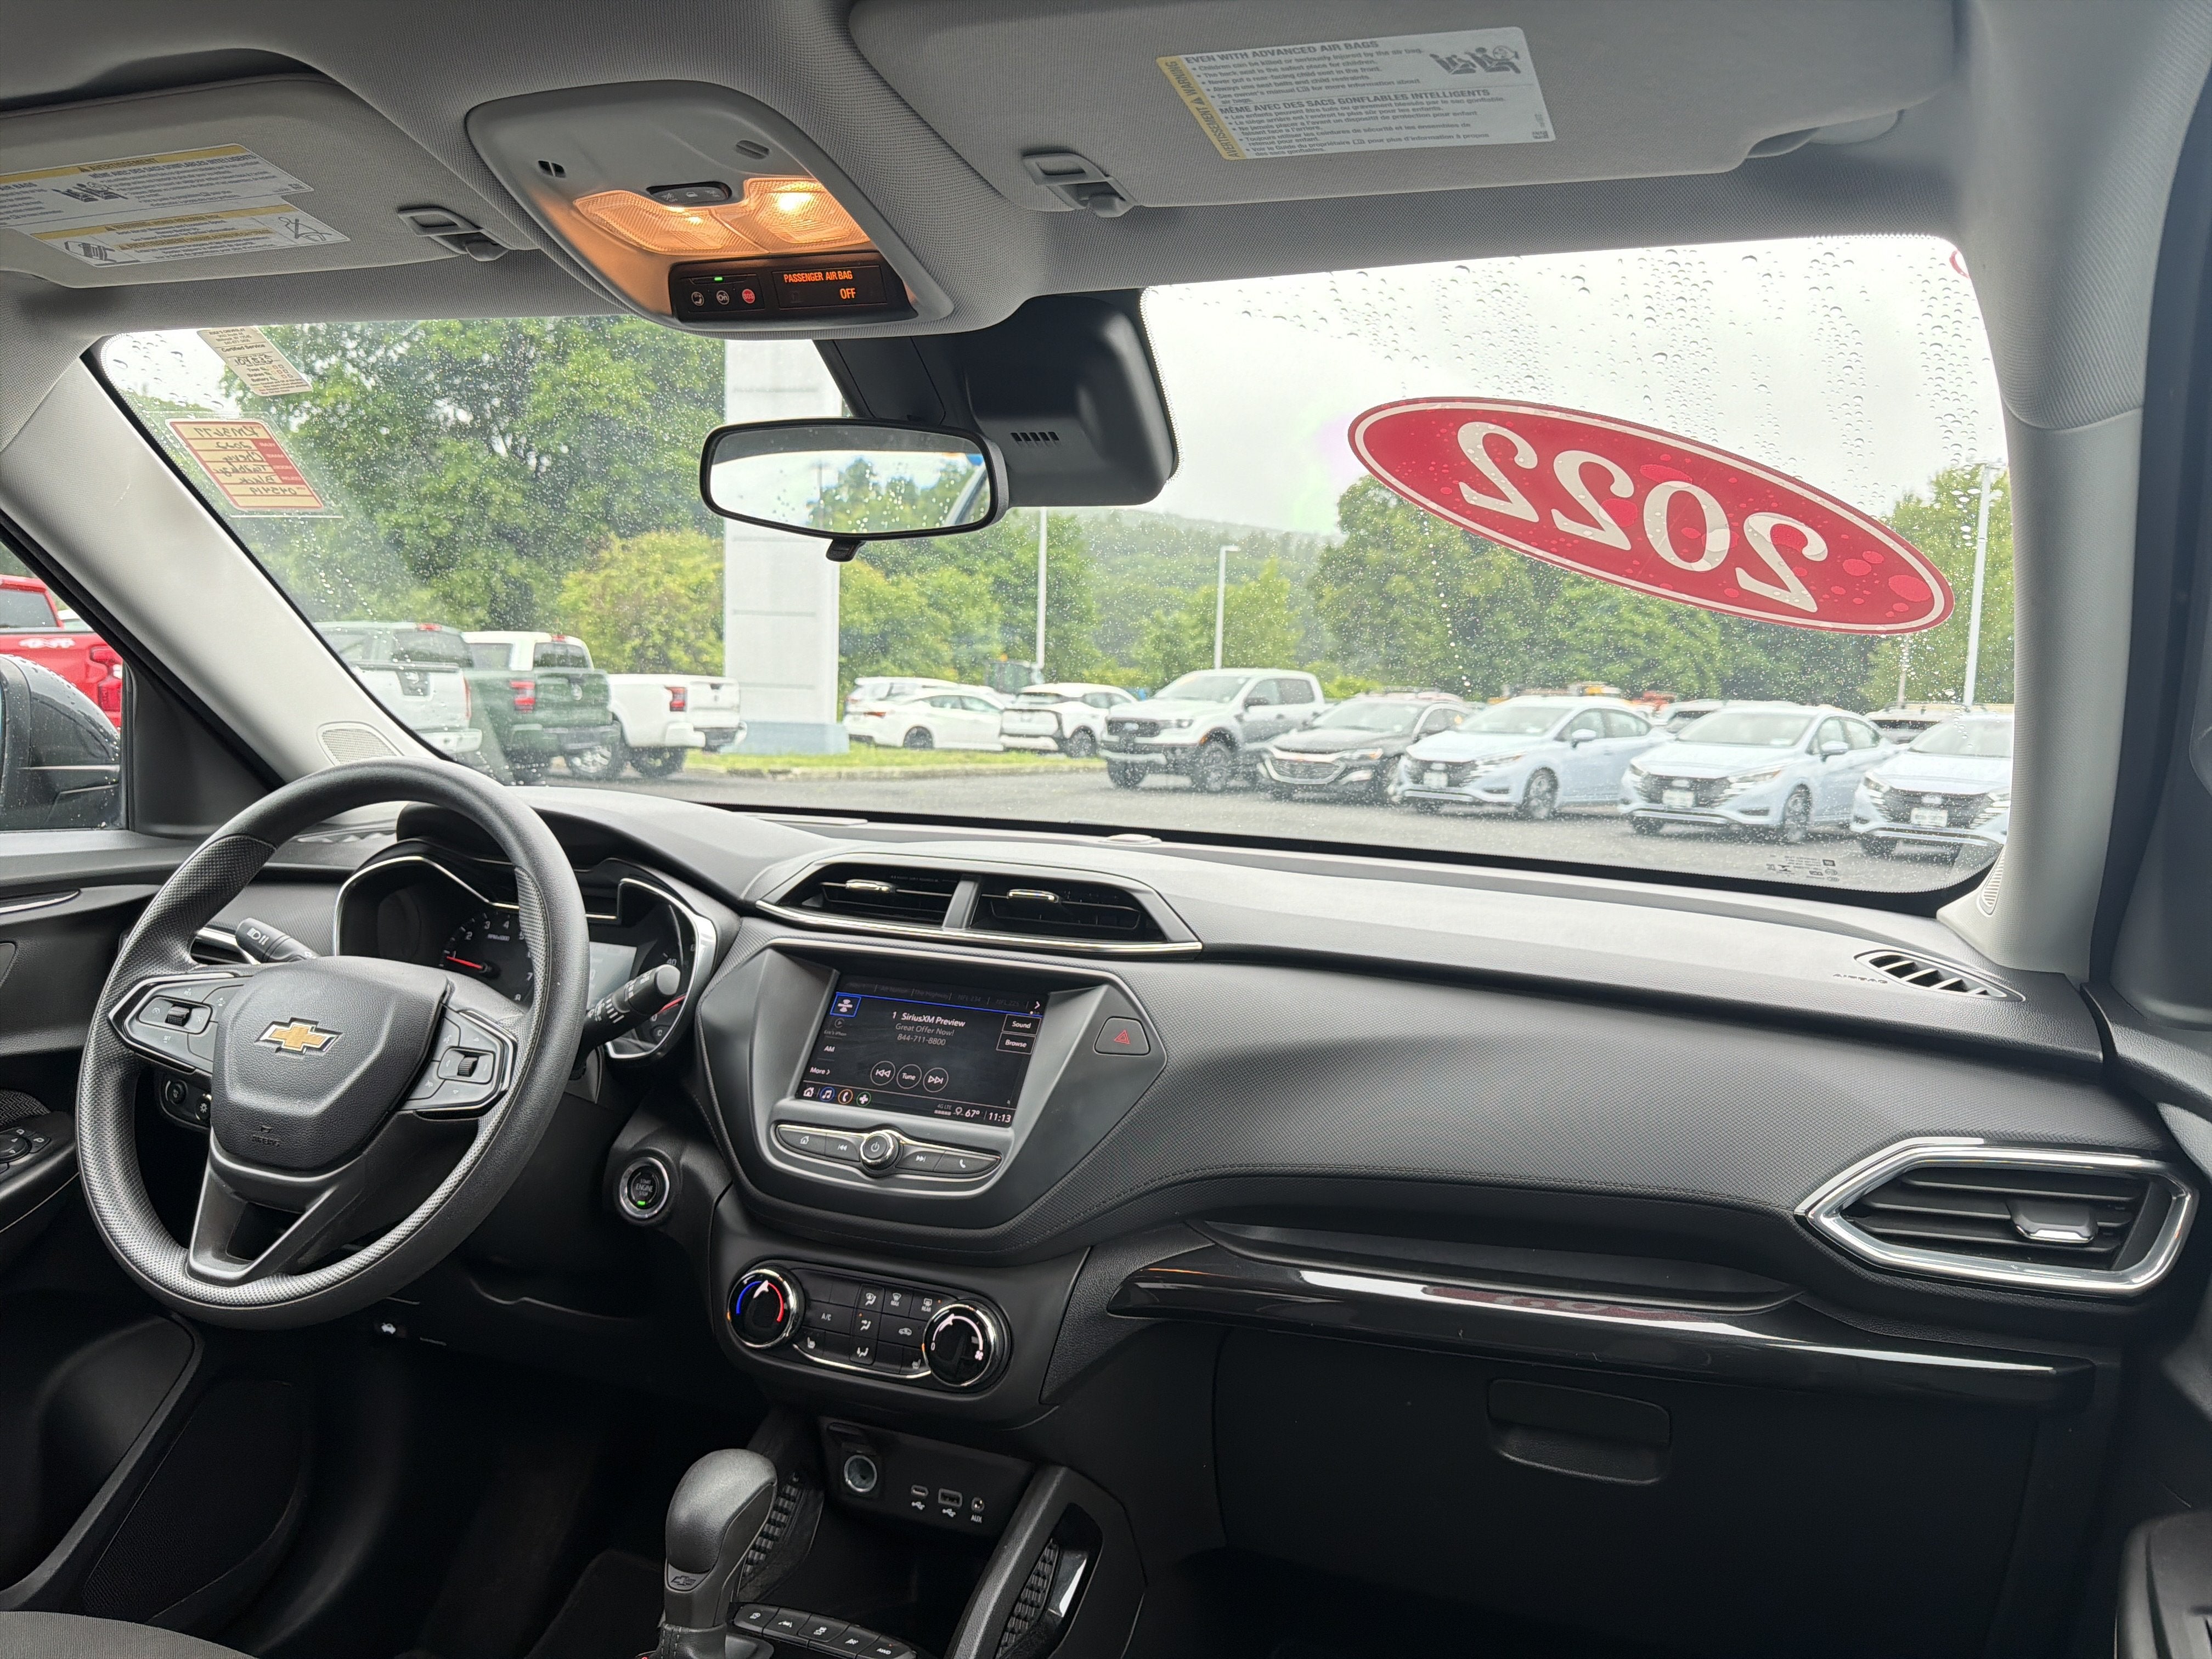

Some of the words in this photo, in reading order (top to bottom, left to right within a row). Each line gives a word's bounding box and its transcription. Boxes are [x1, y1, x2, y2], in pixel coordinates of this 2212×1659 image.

[1184, 55, 1215, 63] EVEN
[1217, 52, 1249, 60] WITH
[1250, 46, 1317, 58] ADVANCED
[1344, 41, 1379, 50] BAGS
[1198, 63, 1232, 71] Children
[1294, 55, 1331, 64] seriously
[1332, 52, 1362, 60] injured
[1165, 61, 1197, 95] WARNING
[1347, 80, 1395, 88] information
[1218, 105, 1251, 114] MÊME
[1306, 99, 1335, 107] SACS
[1337, 93, 1408, 105] GONFLABLES
[1411, 88, 1489, 100] INTELLIGENTS
[1195, 106, 1240, 157] AVERTISSEMENT
[89, 157, 160, 172] AVERTISSEMENT
[783, 272, 824, 283] PASSENGER
[826, 272, 838, 280] AIR
[838, 270, 853, 280] BAG
[718, 292, 727, 301] On
[839, 288, 856, 299] OFF
[483, 921, 490, 930] 3
[503, 921, 510, 929] 4
[465, 931, 473, 940] 2
[526, 972, 533, 981] 7
[892, 1011, 898, 1020] 1
[901, 1013, 935, 1024] SiriusXM
[935, 1016, 966, 1028] Preview
[1012, 1020, 1031, 1029] Sound
[895, 1023, 916, 1032] Great
[916, 1025, 935, 1034] Offer
[936, 1027, 955, 1036] Now!
[897, 1033, 946, 1046] 844-711-8800
[1005, 1039, 1027, 1048] Browse
[810, 1066, 826, 1075] More
[902, 1073, 916, 1081] Tune
[989, 1111, 1012, 1122] 11:13
[636, 1183, 653, 1193] ENGINE
[821, 1313, 832, 1321] A/C
[970, 1515, 983, 1523] AUX
